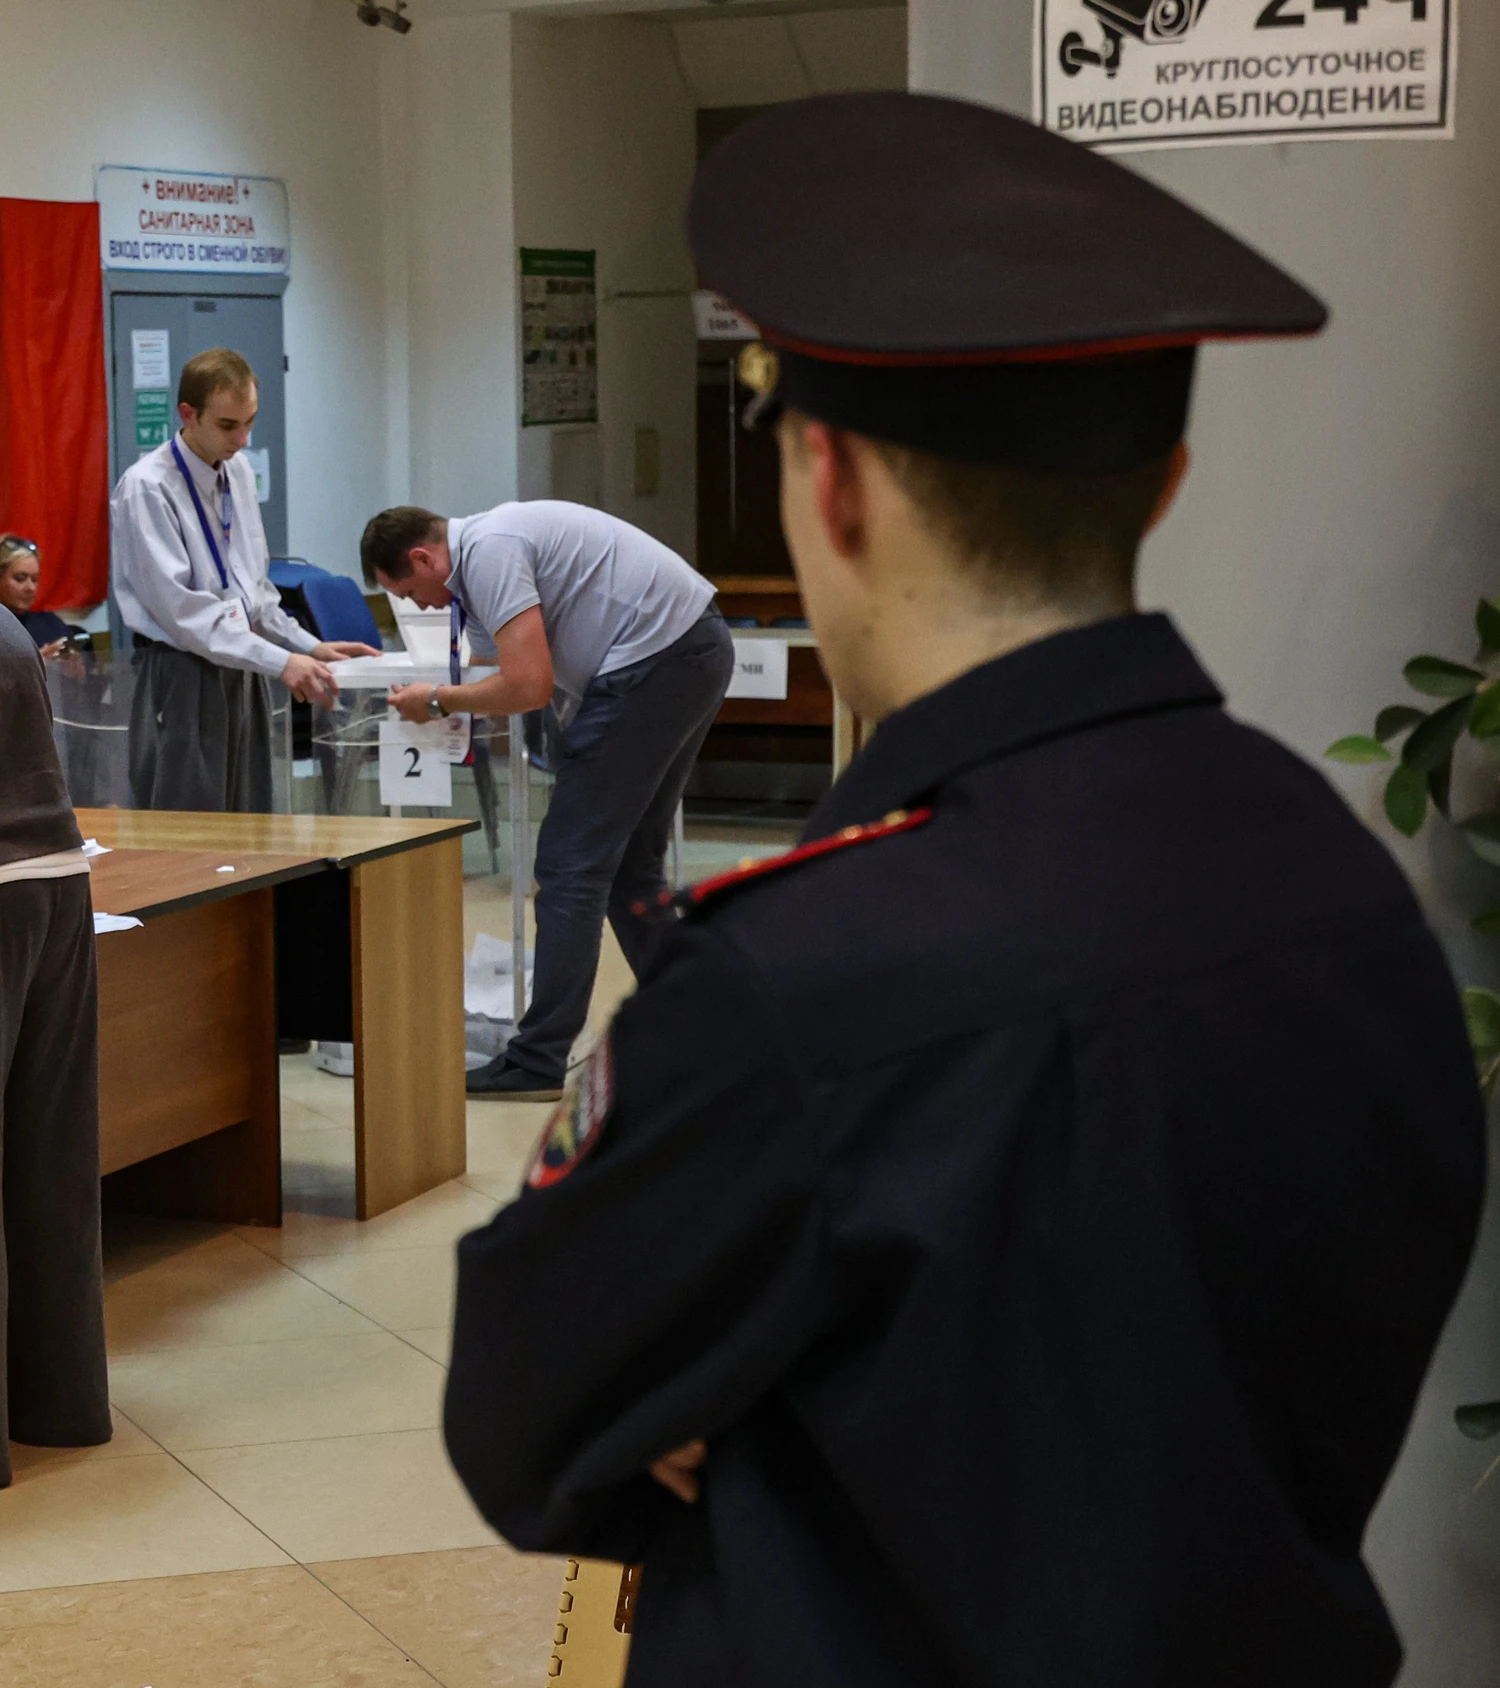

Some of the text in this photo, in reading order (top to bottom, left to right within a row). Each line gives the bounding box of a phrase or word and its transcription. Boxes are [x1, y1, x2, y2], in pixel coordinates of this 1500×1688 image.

[1155, 48, 1427, 85] КРУГЛОСУТОЧНОЕ
[1056, 84, 1427, 132] ВИДЕОНАБЛЮДЕНИЕ
[138, 209, 255, 234] САНИТАРНАЯ ЗОНА
[108, 240, 140, 260] ВХОД
[143, 241, 186, 260] СТРОГО
[188, 244, 195, 260] В
[199, 242, 249, 262] СМЕННОЙ
[403, 746, 423, 778] 2
